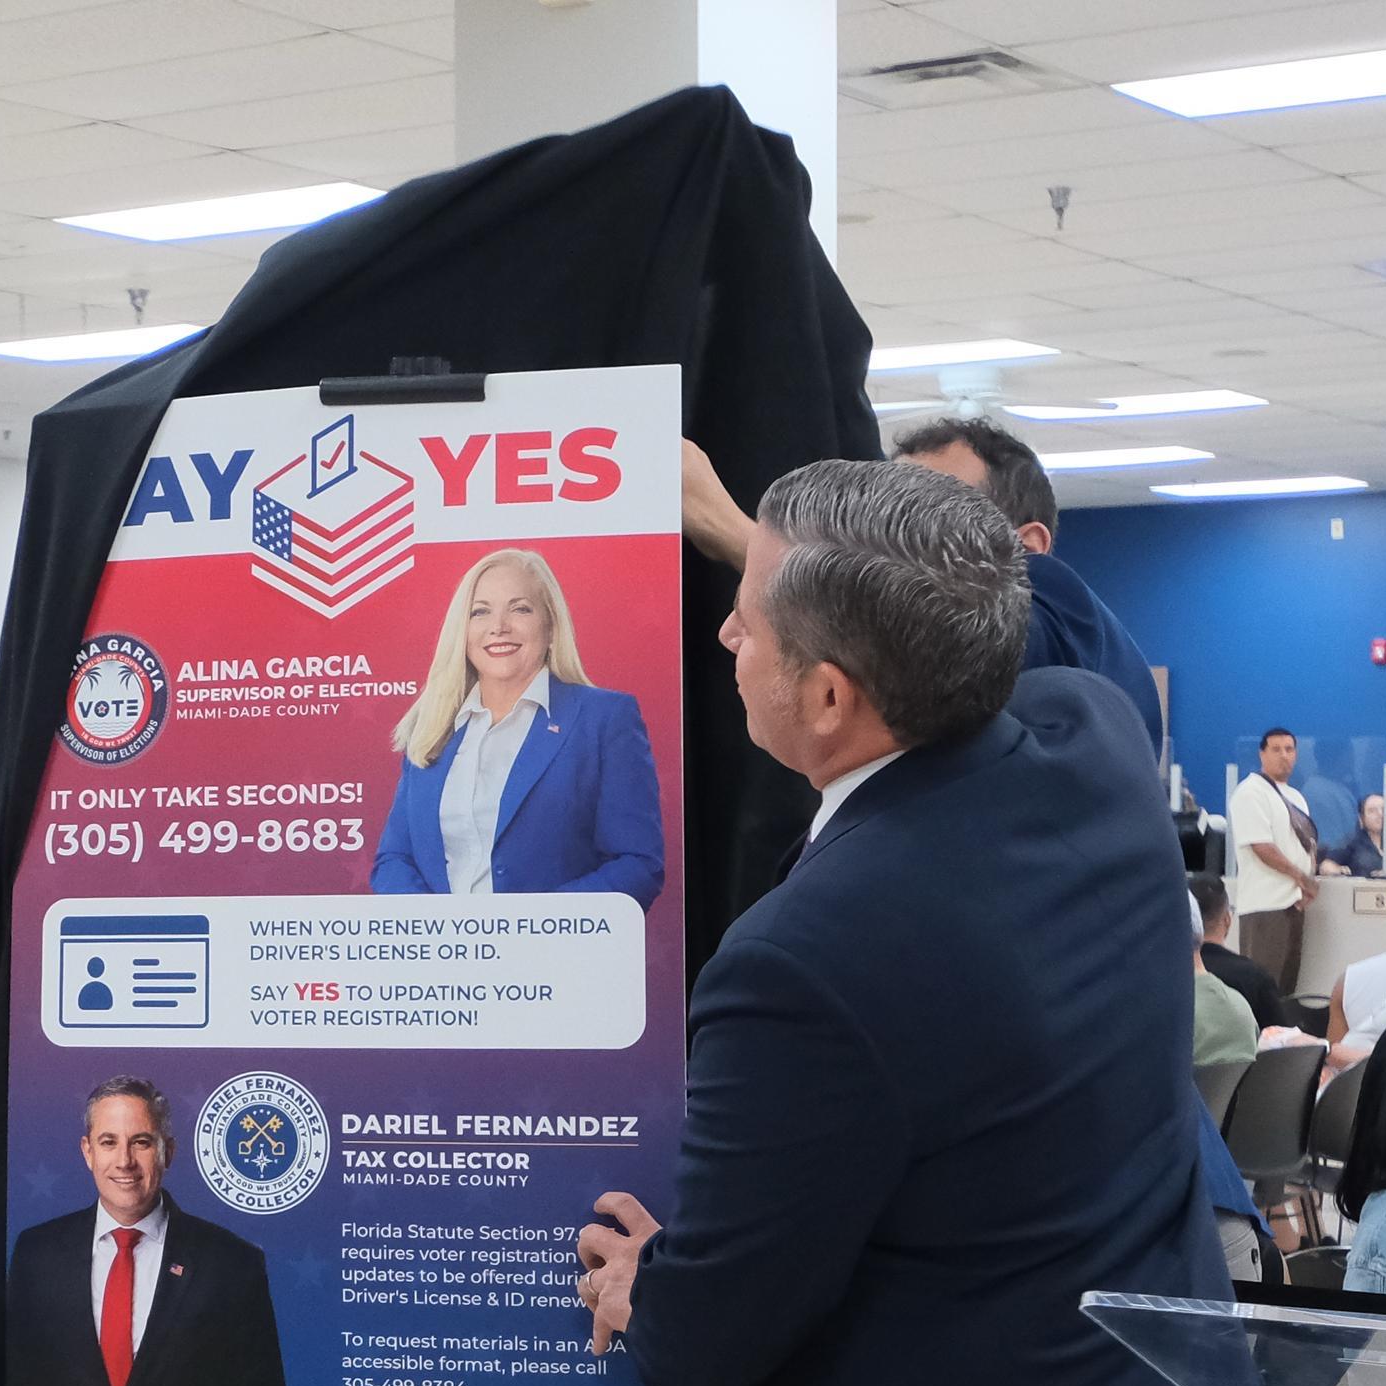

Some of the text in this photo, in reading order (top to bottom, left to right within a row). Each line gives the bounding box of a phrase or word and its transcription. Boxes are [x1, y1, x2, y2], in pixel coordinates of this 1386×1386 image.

[123, 427, 621, 527] AY YES
[107, 639, 164, 692] GARCIA
[176, 654, 372, 682] ALINA GARCIA
[176, 680, 418, 702] SUPERVISOR OF ELECTIONS
[78, 699, 138, 718] VOTE
[177, 704, 339, 720] MIAMI-DADE COUNTY
[60, 719, 158, 760] SUPERVISOR OF ELECTIONS
[51, 783, 362, 810] IT ONLY TAKE SECONDS!
[45, 819, 364, 864] (305) 499-8683
[250, 918, 611, 936] WHEN YOU RENEW YOUR FLORIDA
[251, 944, 500, 960] DRIVER'S LICENSE OR ID.
[251, 983, 552, 1001] SAY YES TO UPDATING YOUR
[250, 1010, 477, 1025] VOTER REGISTRATION!
[202, 1078, 322, 1136] DARIEL FERNANDEZ
[217, 1093, 272, 1136] MIAMI-DADE
[342, 1114, 638, 1136] DARIEL FERNANDEZ
[342, 1151, 529, 1169] TAX COLLECTOR
[209, 1167, 316, 1207] TAX COLLECTOR
[344, 1173, 528, 1187] MIAMI-DADE COUNTY
[342, 1223, 578, 1241] Florida Statute Section 97.
[342, 1245, 576, 1265] requires voter registration
[342, 1267, 582, 1285] updates to be offered duri
[343, 1288, 587, 1308] Driver's License & ID renew
[341, 1332, 363, 1346] To
[369, 1336, 437, 1350] request
[443, 1336, 528, 1350] materials
[534, 1336, 549, 1351] in
[556, 1341, 578, 1352] an
[342, 1355, 606, 1376] accessible format, please call
